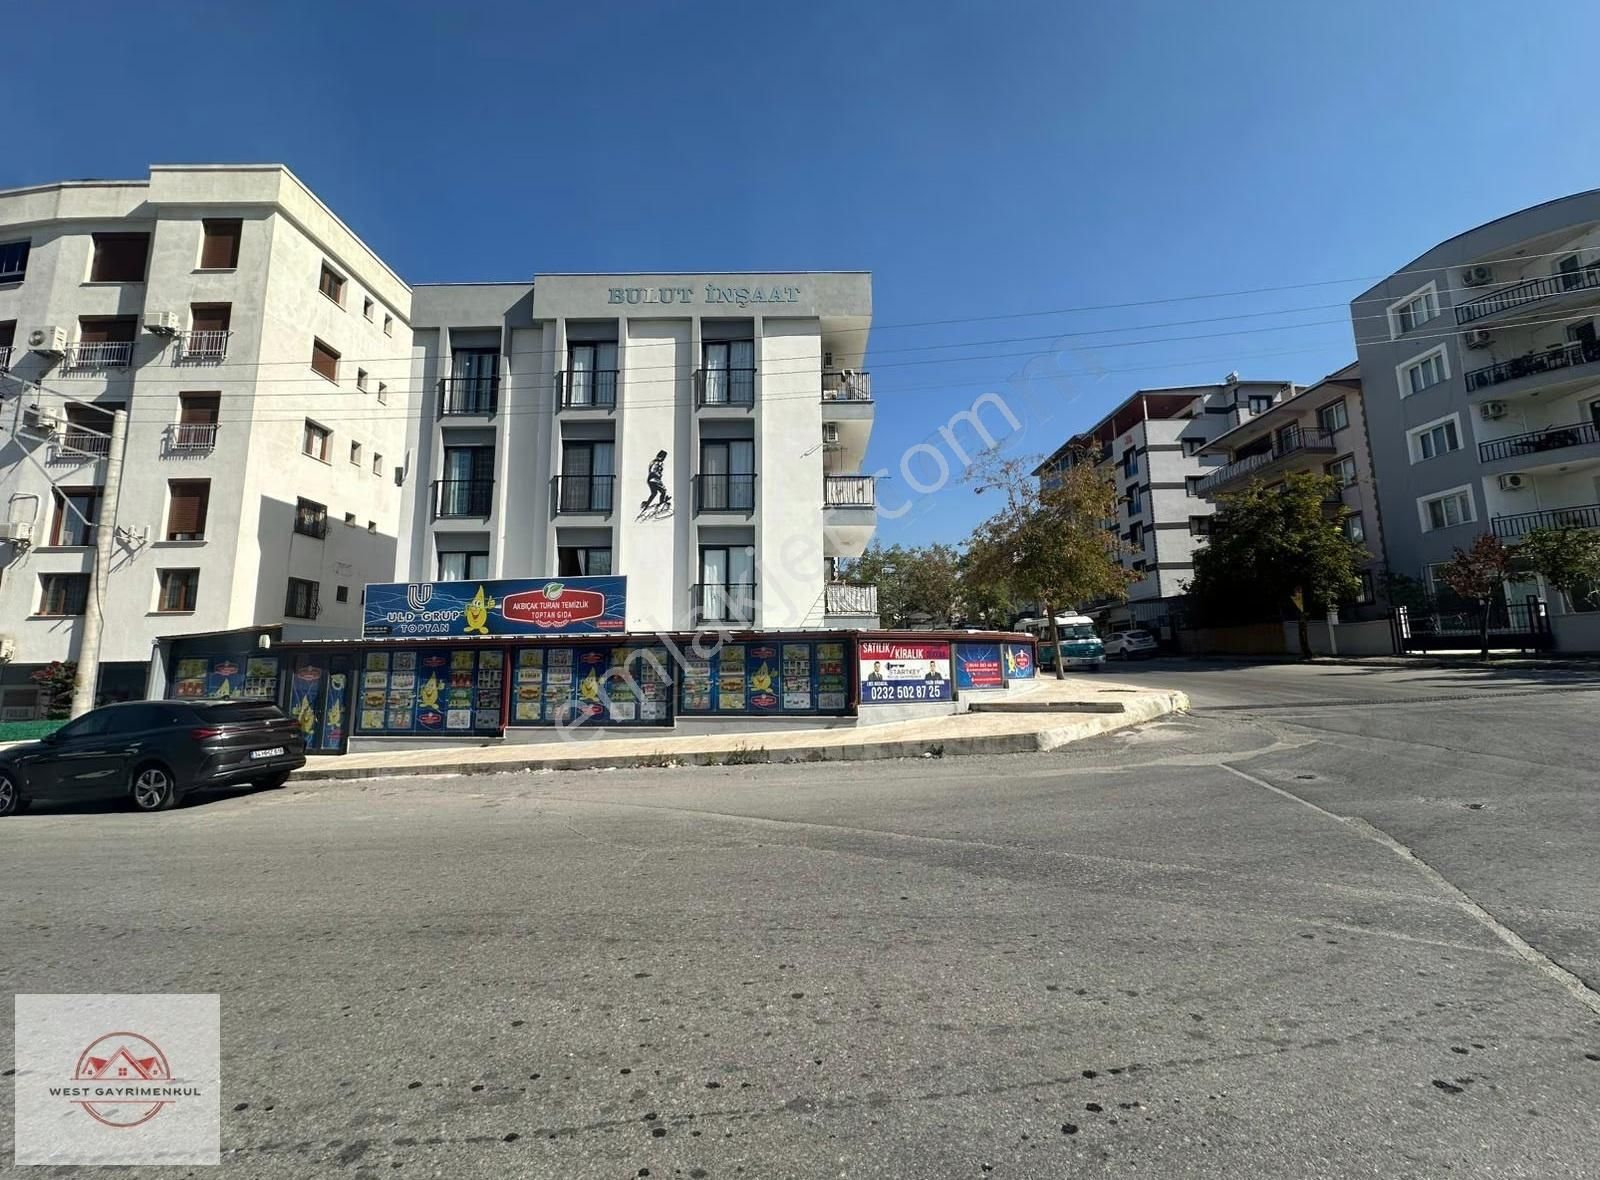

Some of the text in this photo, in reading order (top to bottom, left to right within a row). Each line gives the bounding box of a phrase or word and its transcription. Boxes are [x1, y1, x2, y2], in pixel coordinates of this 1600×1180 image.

[608, 284, 801, 308] BULUT İNŞAAT
[387, 611, 460, 622] ULD GRUP
[400, 624, 450, 633] TOPTAN
[871, 686, 894, 700] 0232
[916, 685, 926, 698] 87
[928, 685, 940, 698] 25
